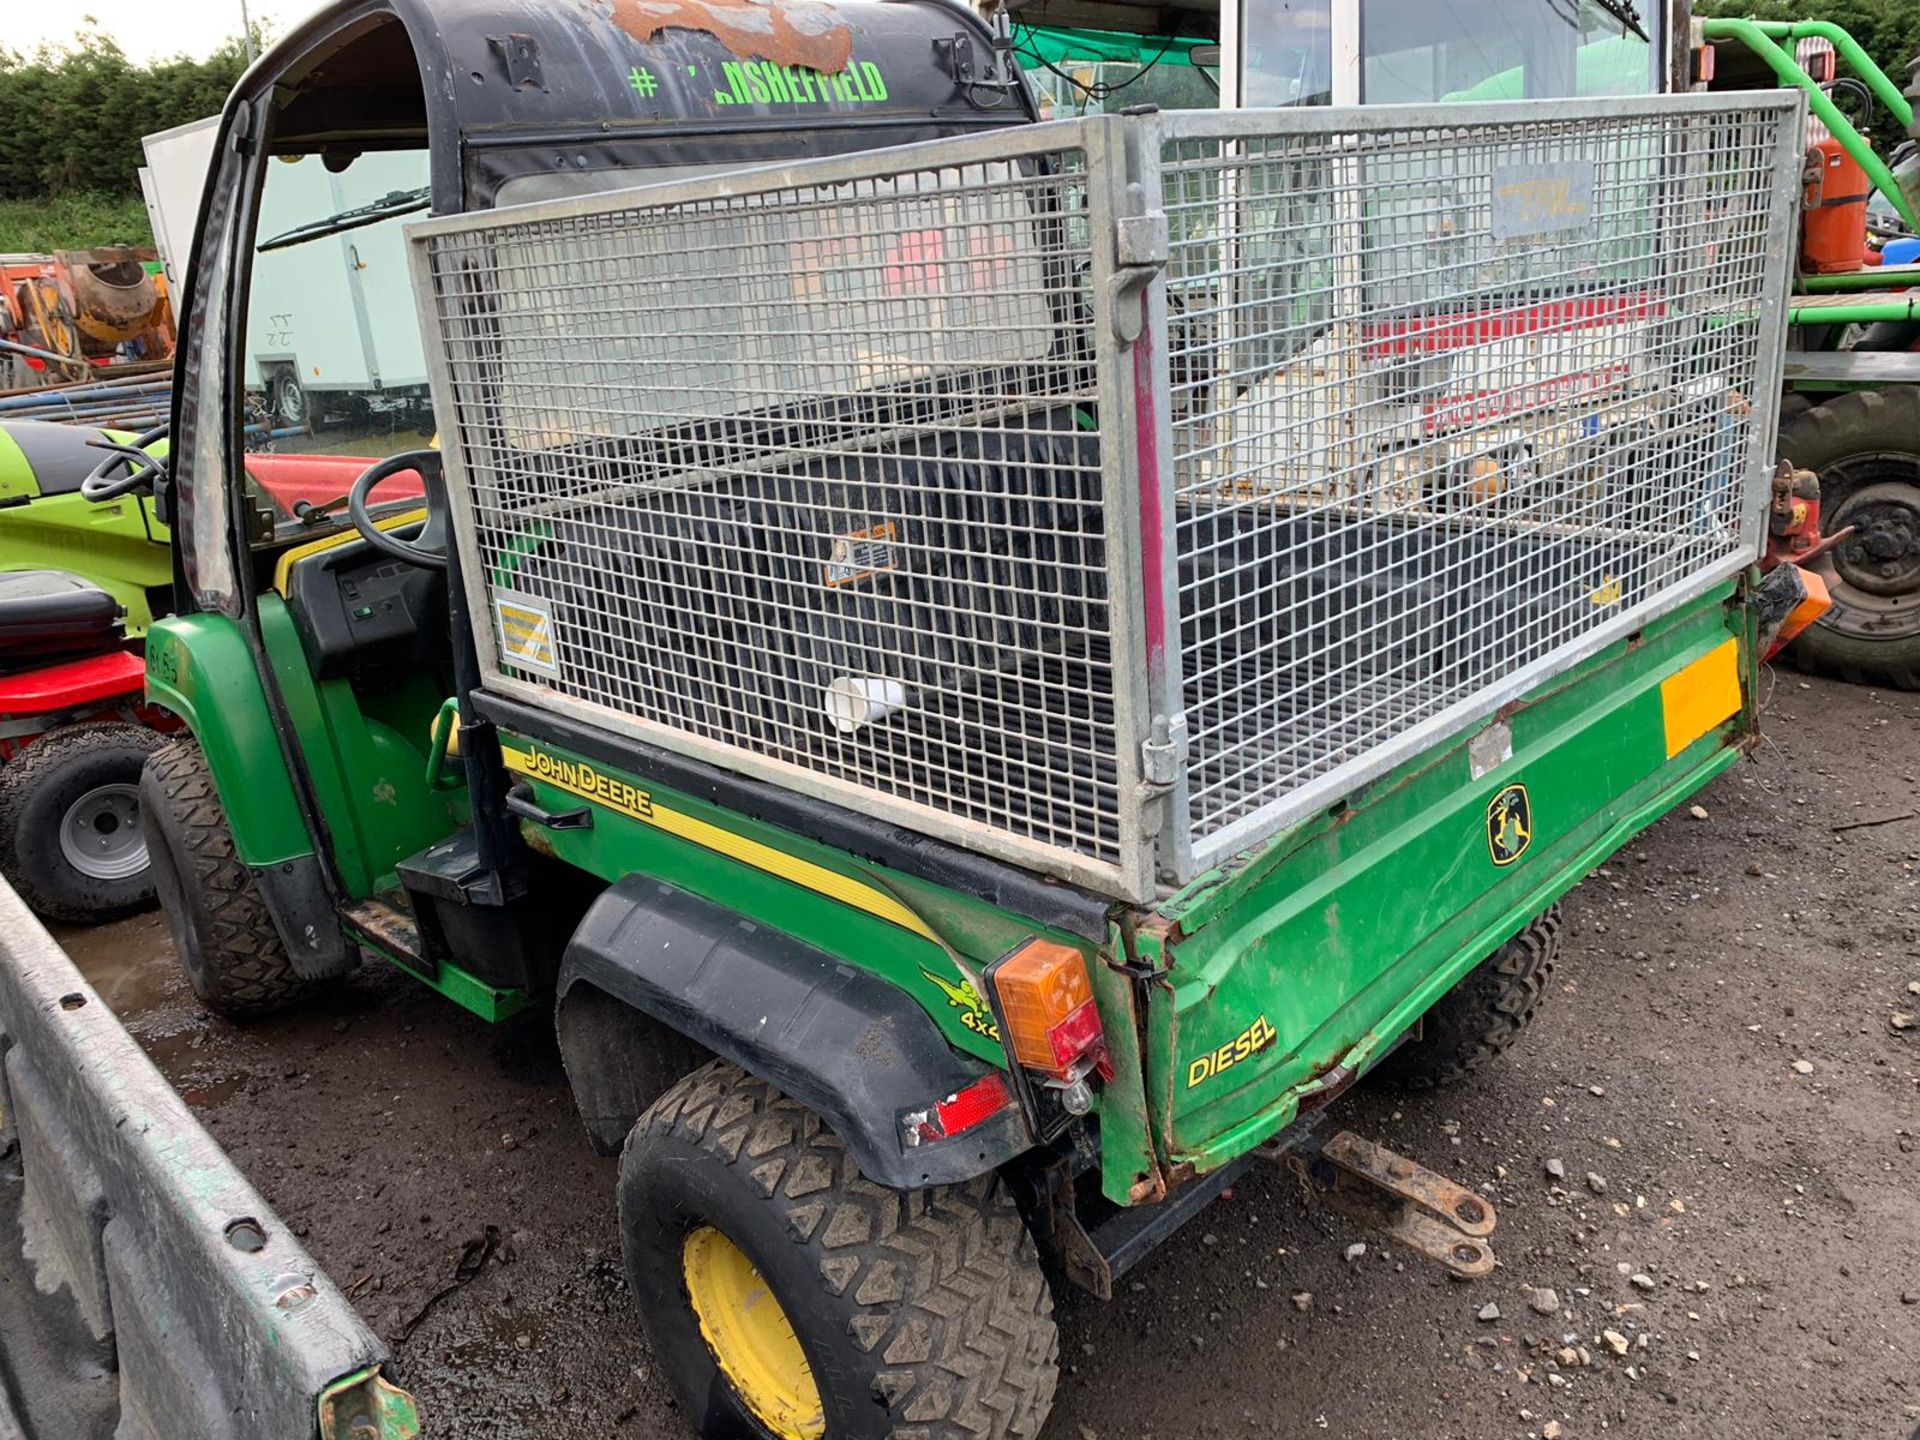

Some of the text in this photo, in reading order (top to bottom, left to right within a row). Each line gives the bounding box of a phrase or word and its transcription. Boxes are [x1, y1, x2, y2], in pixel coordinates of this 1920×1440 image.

[525, 745, 653, 818] JOHN DEERE
[1187, 1014, 1276, 1089] DIESEL
